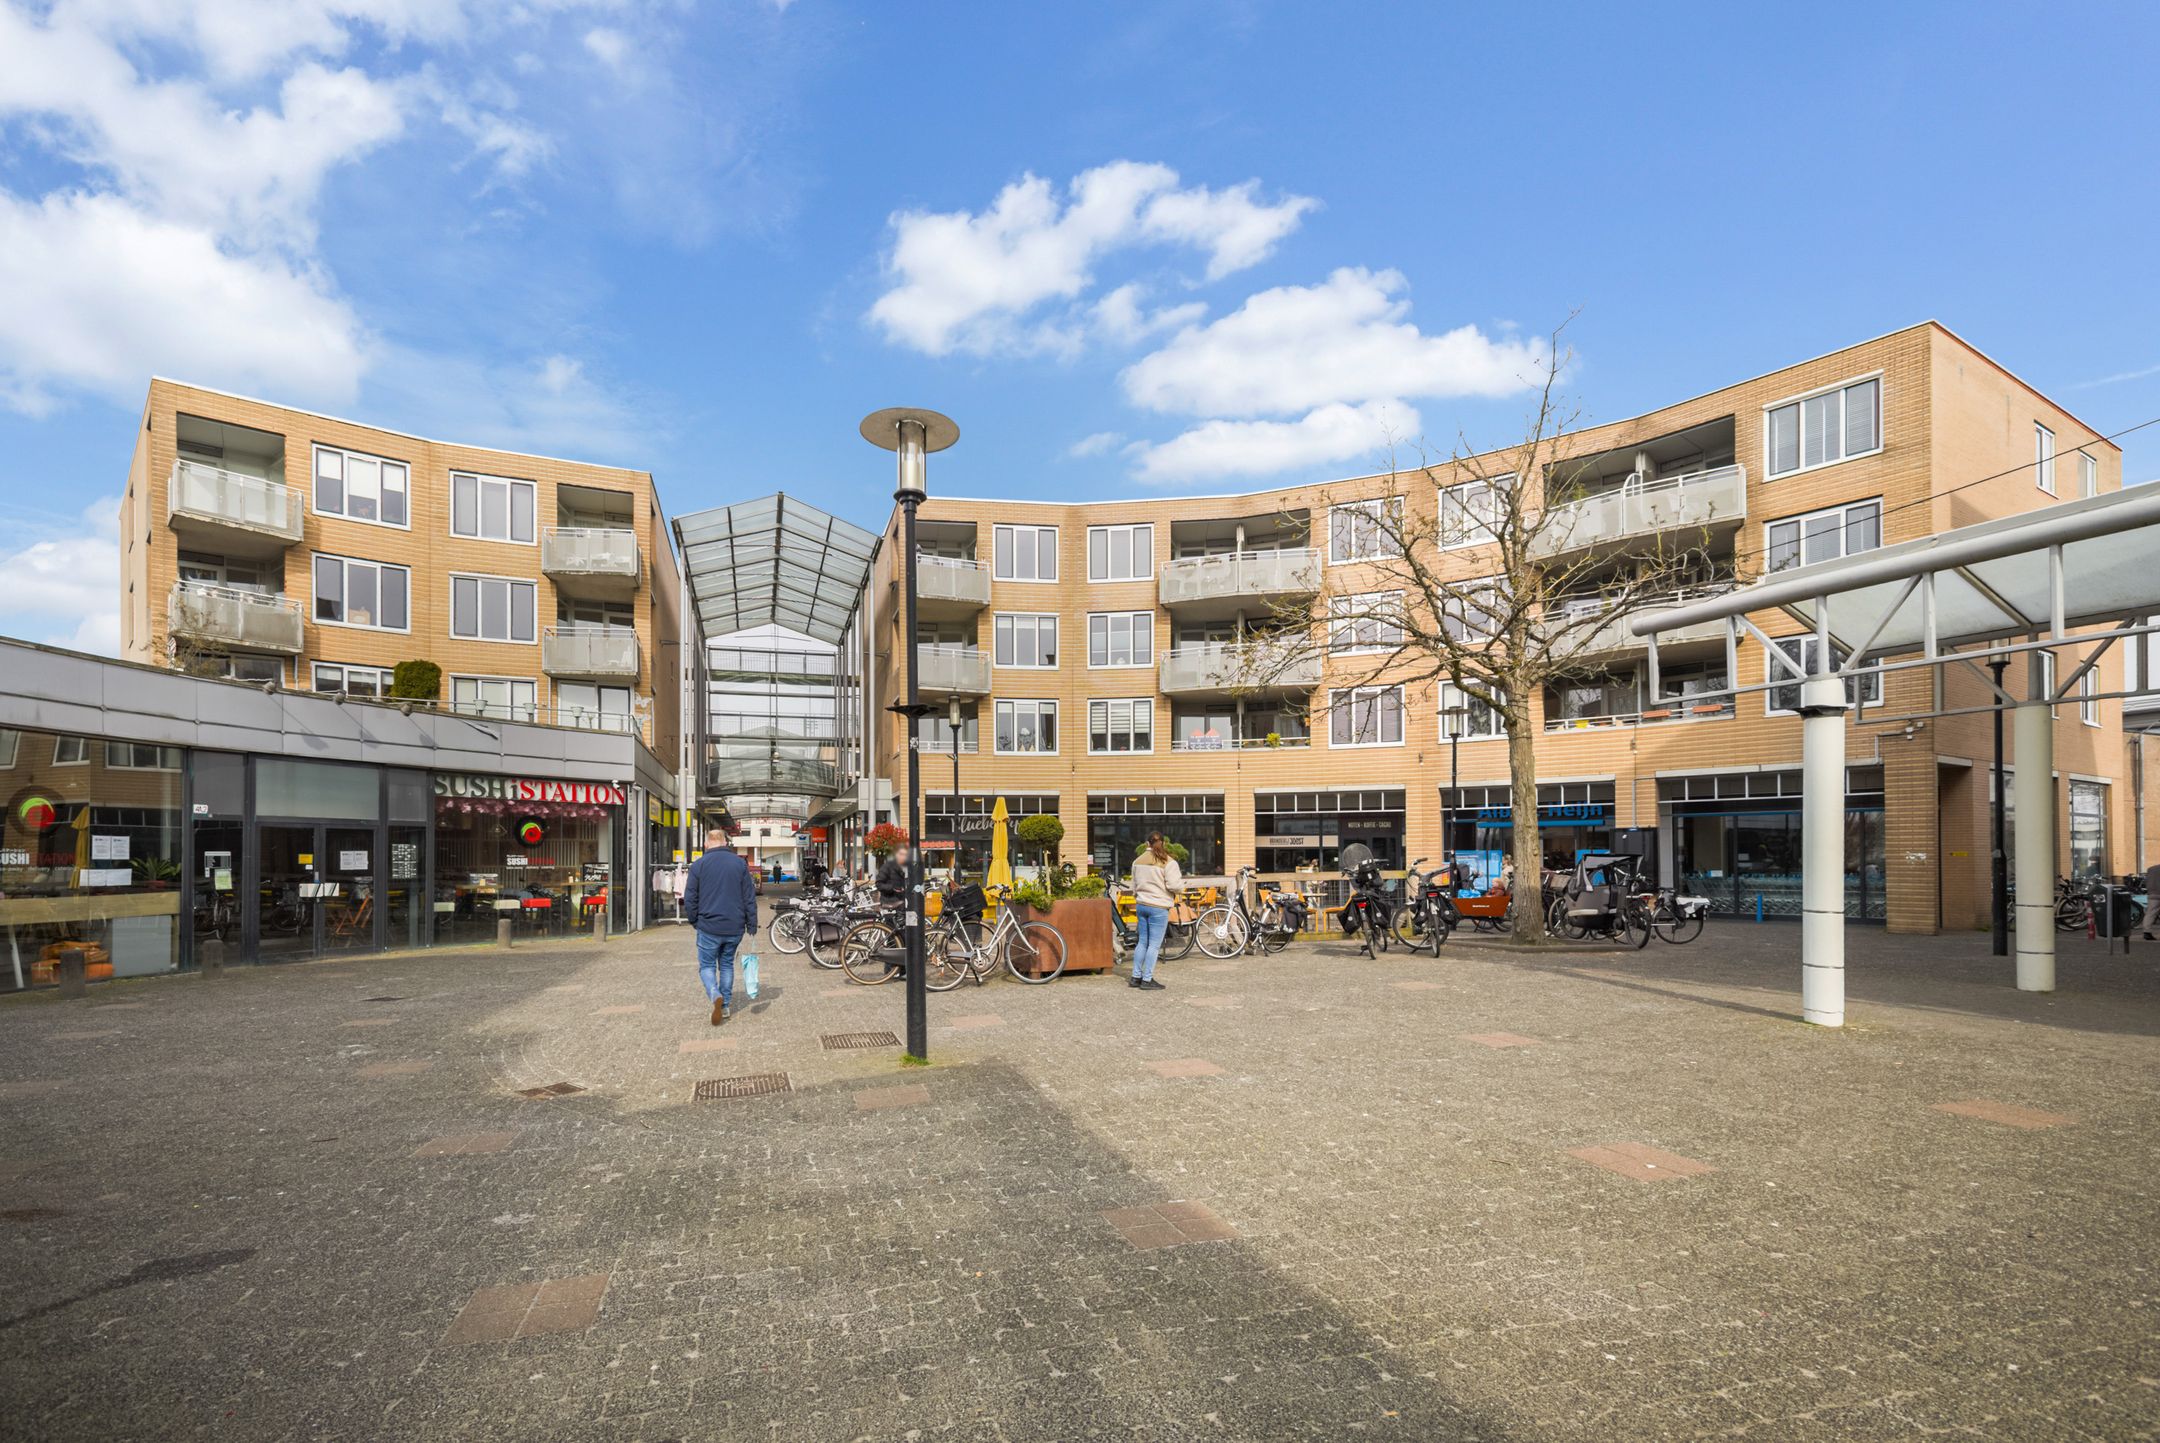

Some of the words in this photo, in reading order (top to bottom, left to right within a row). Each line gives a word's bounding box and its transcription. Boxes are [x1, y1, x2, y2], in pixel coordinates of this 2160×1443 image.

[1549, 801, 1603, 819] Heijn
[950, 816, 1019, 835] Bluebey
[0, 852, 30, 865] USHI
